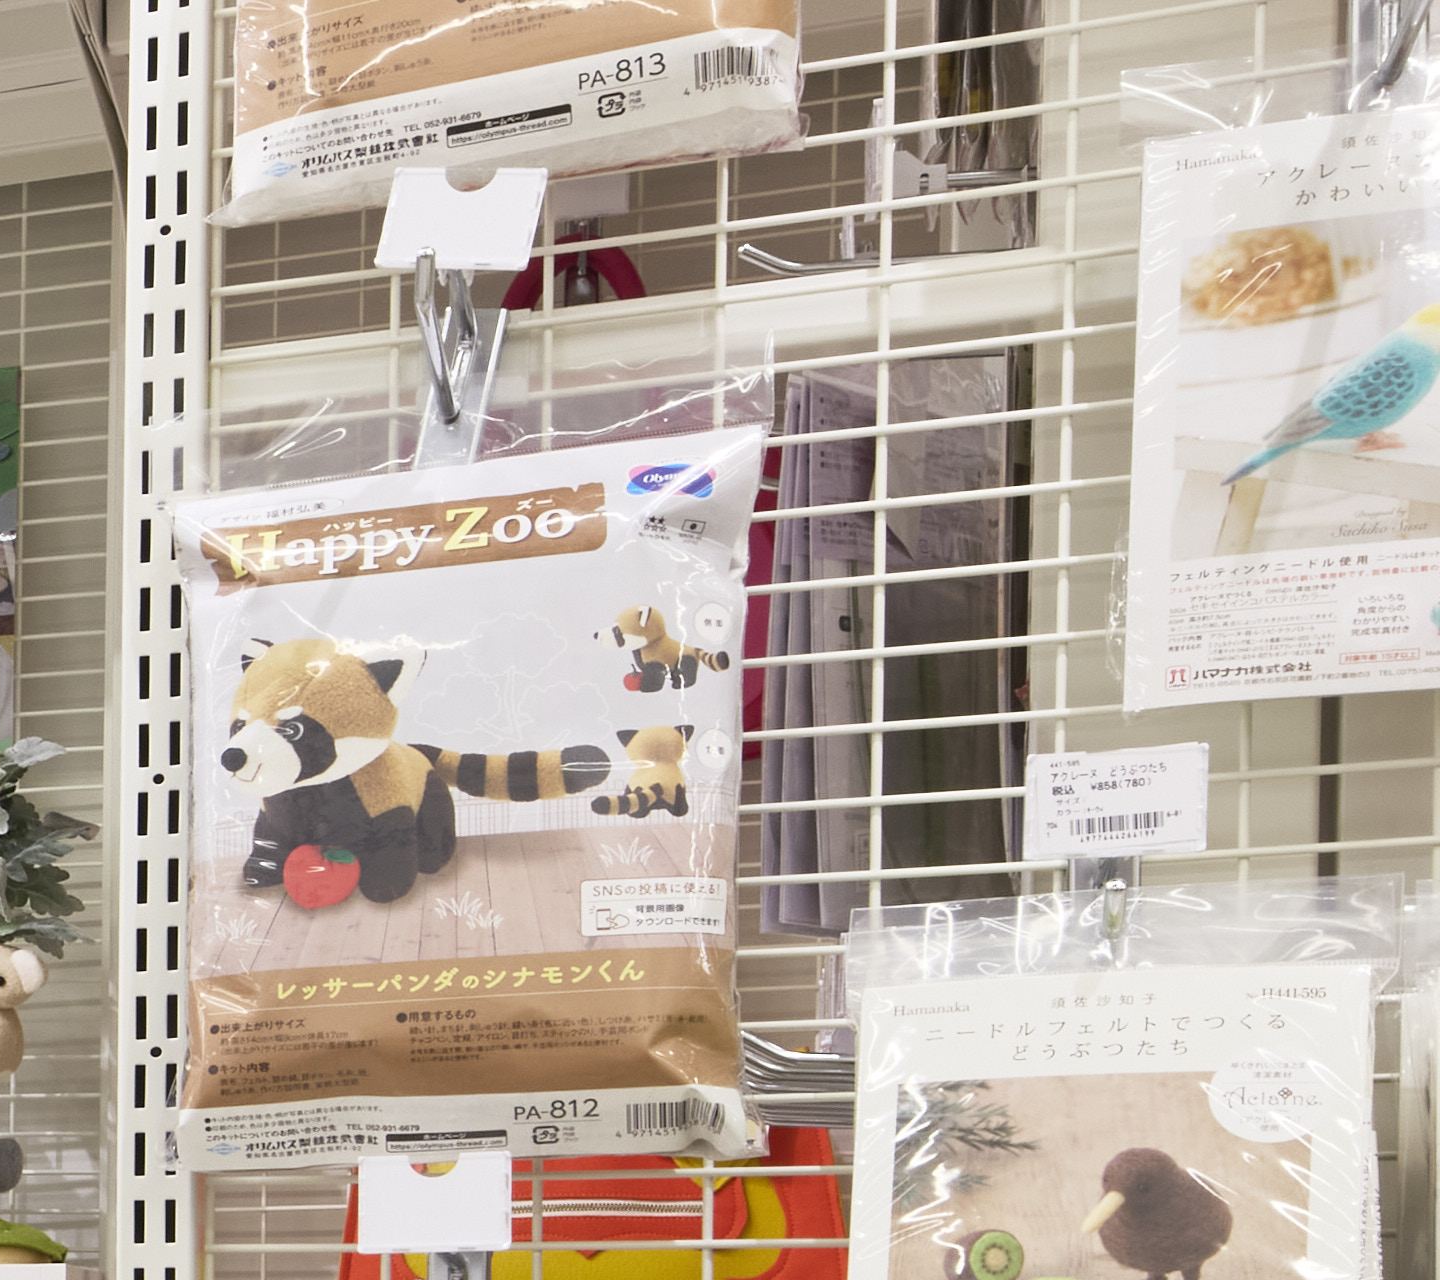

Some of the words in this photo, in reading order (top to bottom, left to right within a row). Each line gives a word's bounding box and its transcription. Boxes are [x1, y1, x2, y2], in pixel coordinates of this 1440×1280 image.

[577, 52, 668, 90] PA-813
[403, 123, 421, 133] TEL
[1176, 150, 1257, 171] Hamanaka
[516, 498, 554, 511] ズー
[323, 517, 393, 533] ハッピー
[226, 523, 435, 580] Happy
[443, 505, 575, 552] Zoo
[1170, 555, 1369, 582] フェルティングニードル使用
[1193, 661, 1313, 681] ハマナカ株式会社
[1110, 762, 1167, 777] どうぶつたち
[1052, 785, 1075, 796] 税込
[1091, 778, 1152, 791] ¥858(780)
[592, 882, 721, 899] SNSの投稿に使える!
[277, 959, 646, 1000] レッサーパンダのシナモンくん
[408, 1008, 477, 1024] 用意するもの
[893, 1003, 971, 1017] Hamanaka
[925, 1013, 1287, 1042] ニードルフェルトでつくる
[1011, 1039, 1189, 1062] どうぶつたち
[513, 1098, 601, 1122] PA-812
